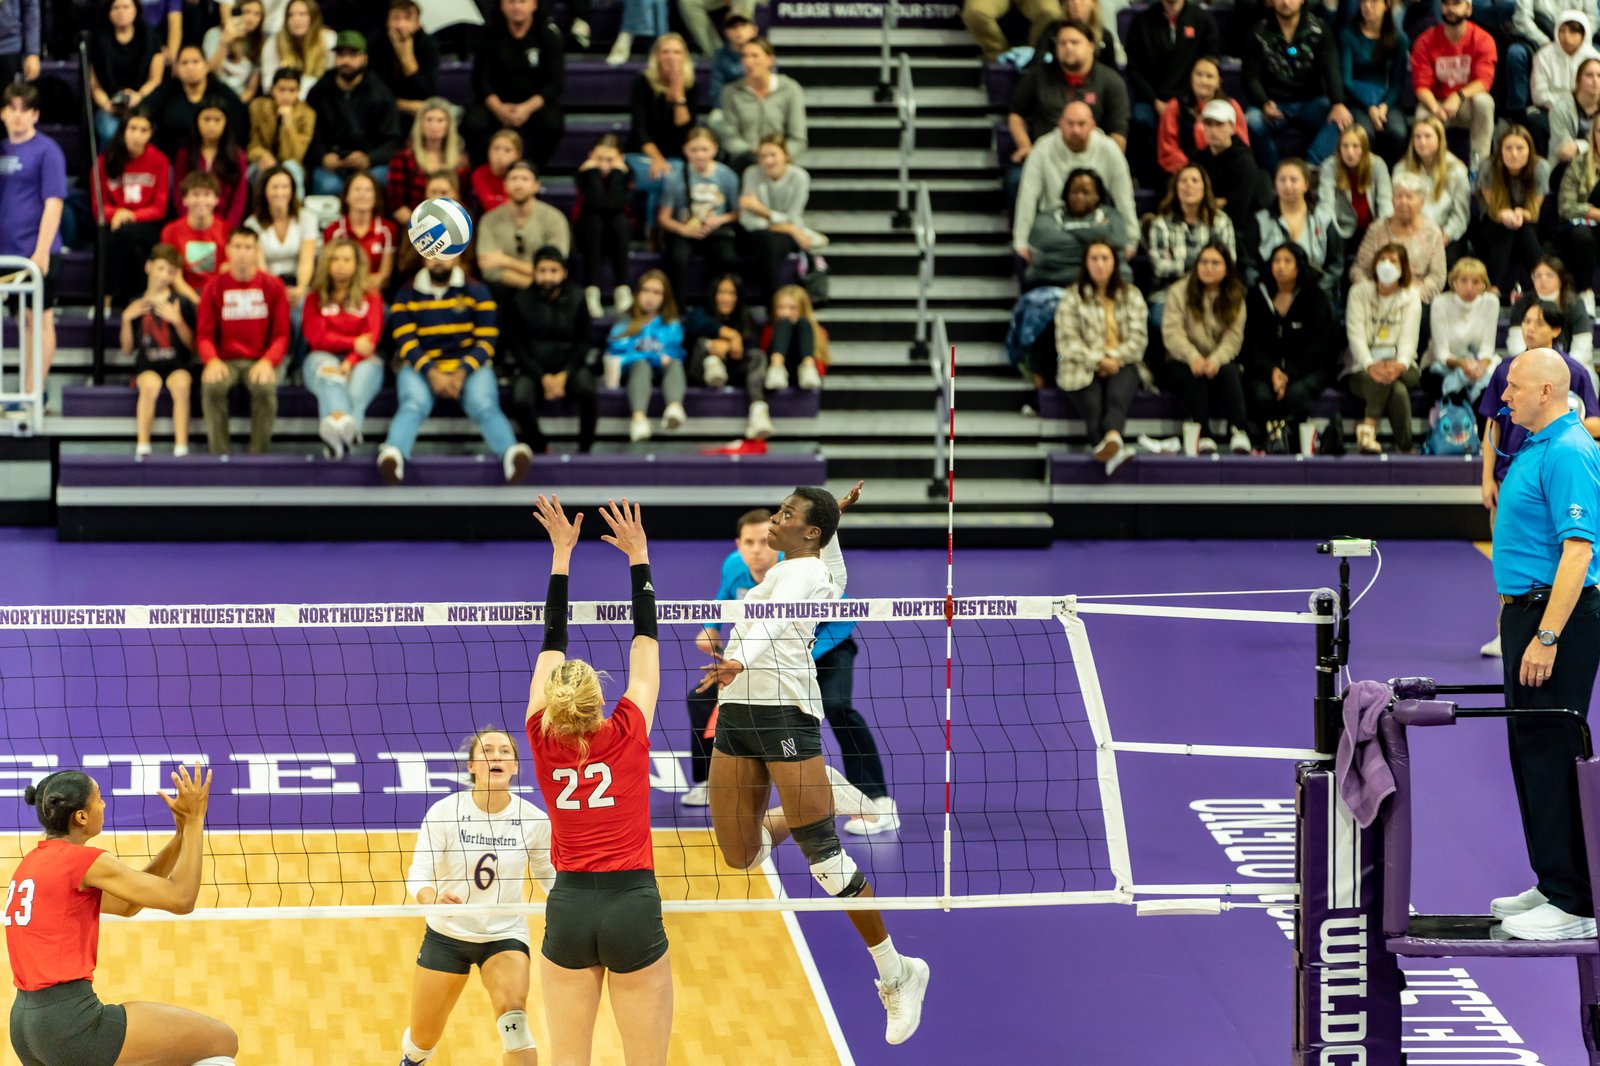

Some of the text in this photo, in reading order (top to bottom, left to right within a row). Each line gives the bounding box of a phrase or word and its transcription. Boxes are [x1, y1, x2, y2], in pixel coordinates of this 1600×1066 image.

[778, 3, 831, 18] PLEASE
[833, 3, 883, 18] WATCH
[0, 608, 126, 625] NORTHWESTERN
[149, 607, 275, 625] NORTHWESTERN
[298, 606, 424, 624] NORTHWESTERN
[448, 605, 573, 621] NORTHWEST
[596, 604, 721, 621] NORTESTERN
[744, 602, 870, 619] NORTHWESTERN
[552, 762, 616, 810] 22
[460, 829, 517, 847] Northwestern
[474, 853, 497, 891] 6
[4, 878, 36, 927] 23
